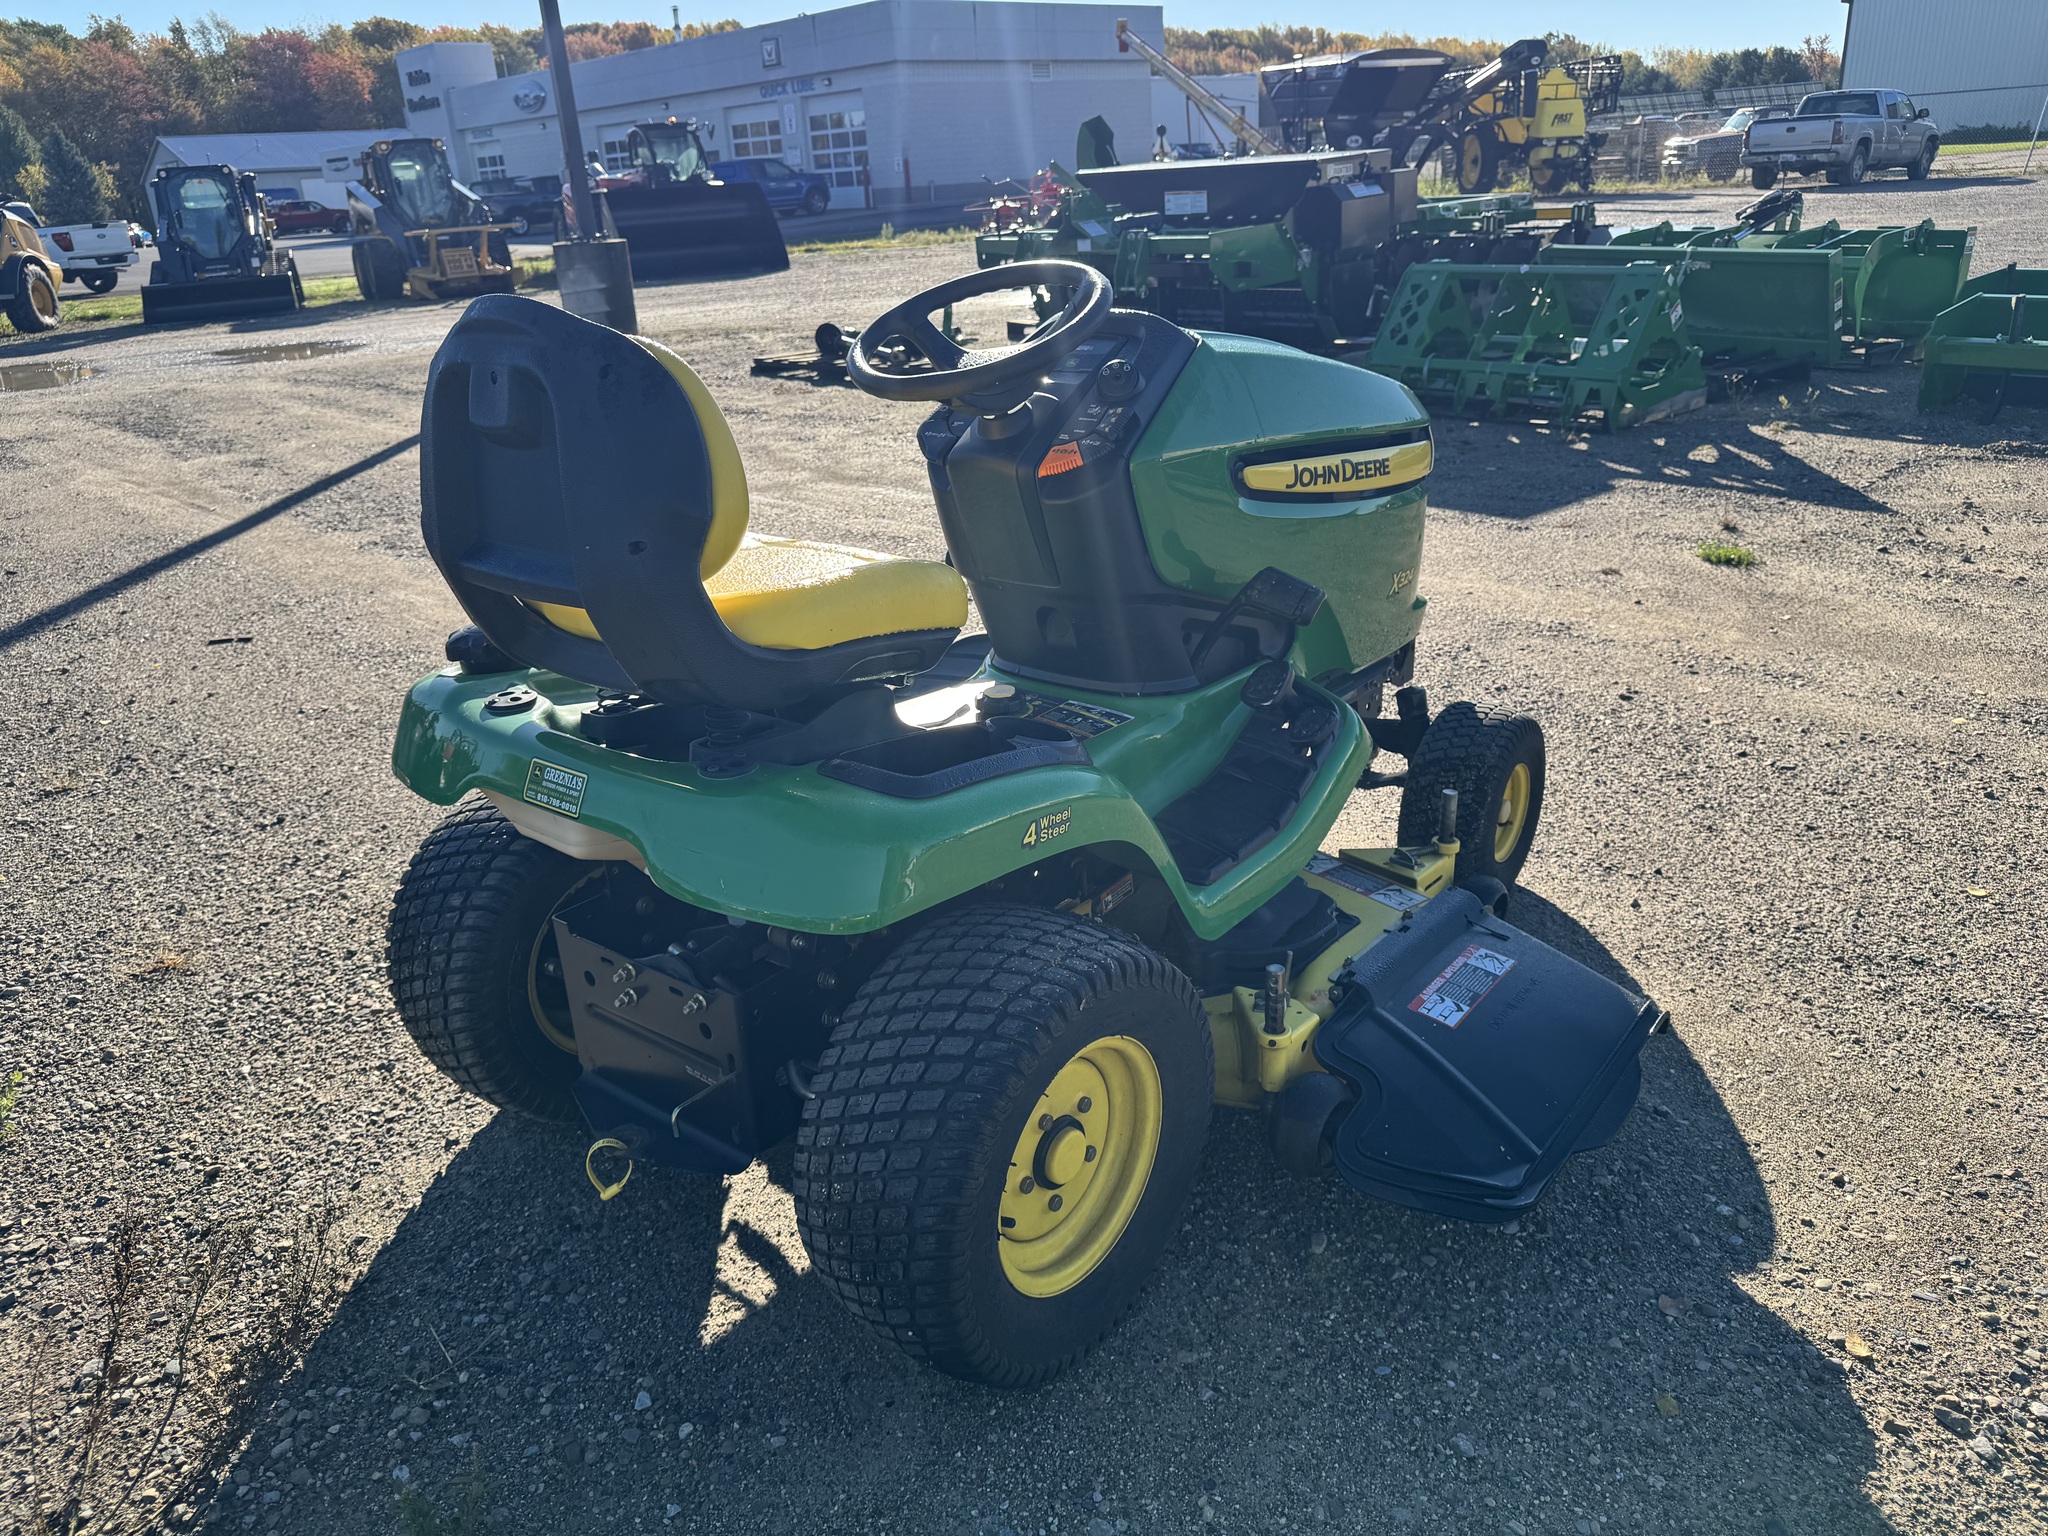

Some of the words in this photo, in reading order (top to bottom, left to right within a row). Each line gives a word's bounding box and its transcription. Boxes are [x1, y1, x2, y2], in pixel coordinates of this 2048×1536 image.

[760, 81, 789, 98] QUICK
[791, 79, 816, 94] LUBE
[1285, 463, 1340, 489] JOHN
[1341, 458, 1391, 482] DEERE
[544, 767, 583, 790] GREENIA'S
[536, 793, 578, 813] 810-798-0010
[1022, 821, 1037, 846] 4
[1040, 806, 1071, 829] Wheel
[1040, 821, 1071, 842] Steer
